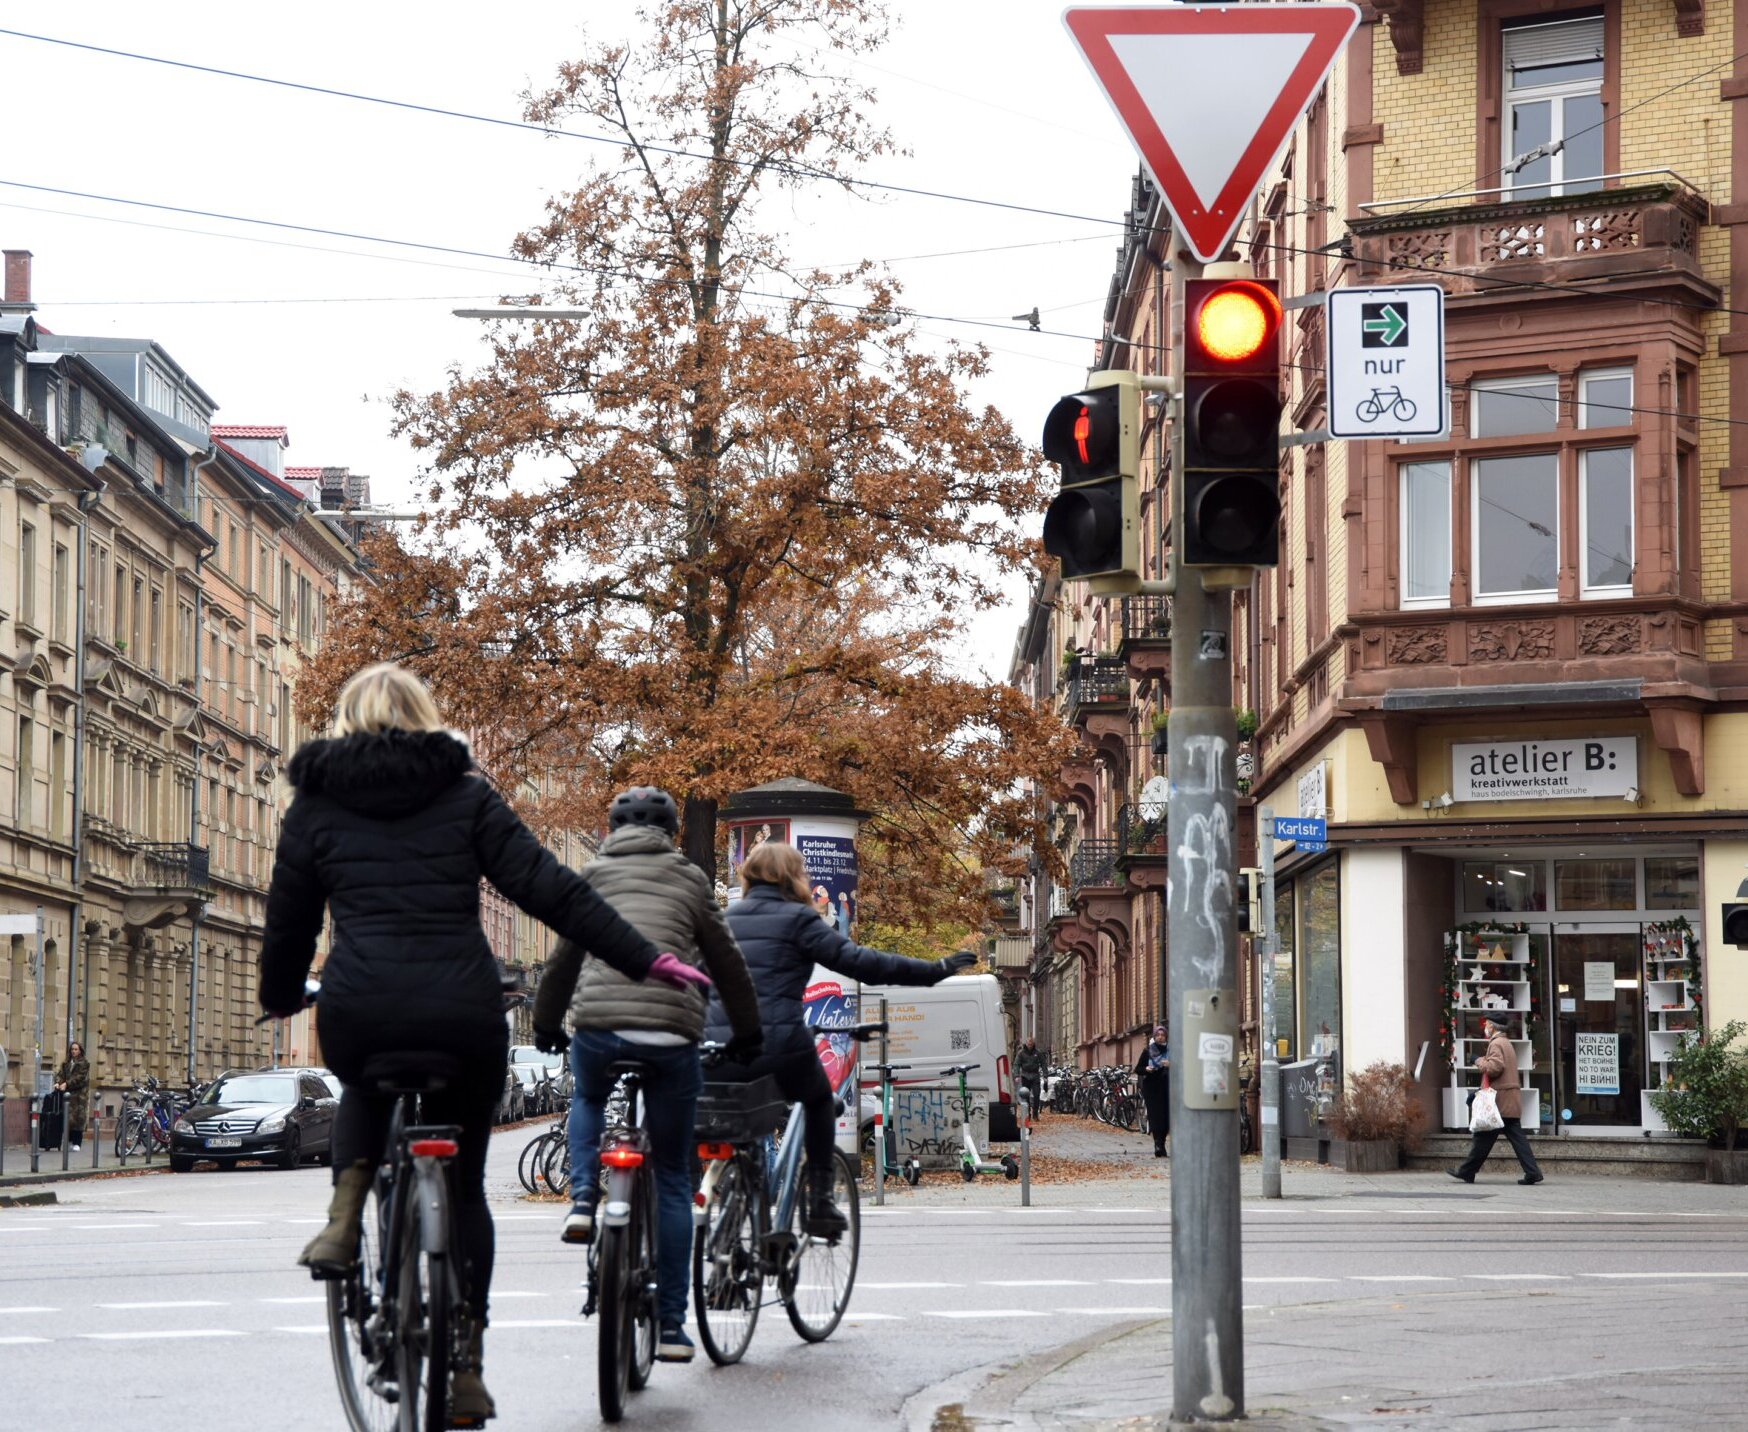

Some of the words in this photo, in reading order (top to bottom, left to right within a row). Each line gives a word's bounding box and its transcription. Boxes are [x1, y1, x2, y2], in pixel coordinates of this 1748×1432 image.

[1364, 358, 1406, 375] nur
[1470, 744, 1573, 776] atelier
[1585, 742, 1616, 771] B:
[1471, 776, 1568, 788] kreativwerkstatt
[1471, 788, 1489, 798] haus
[1551, 786, 1588, 796] karlsruhe
[1277, 821, 1322, 836] Karlstr.
[803, 840, 836, 848] Karlsruher
[823, 857, 832, 865] bis
[1579, 1045, 1615, 1055] KRIEG!
